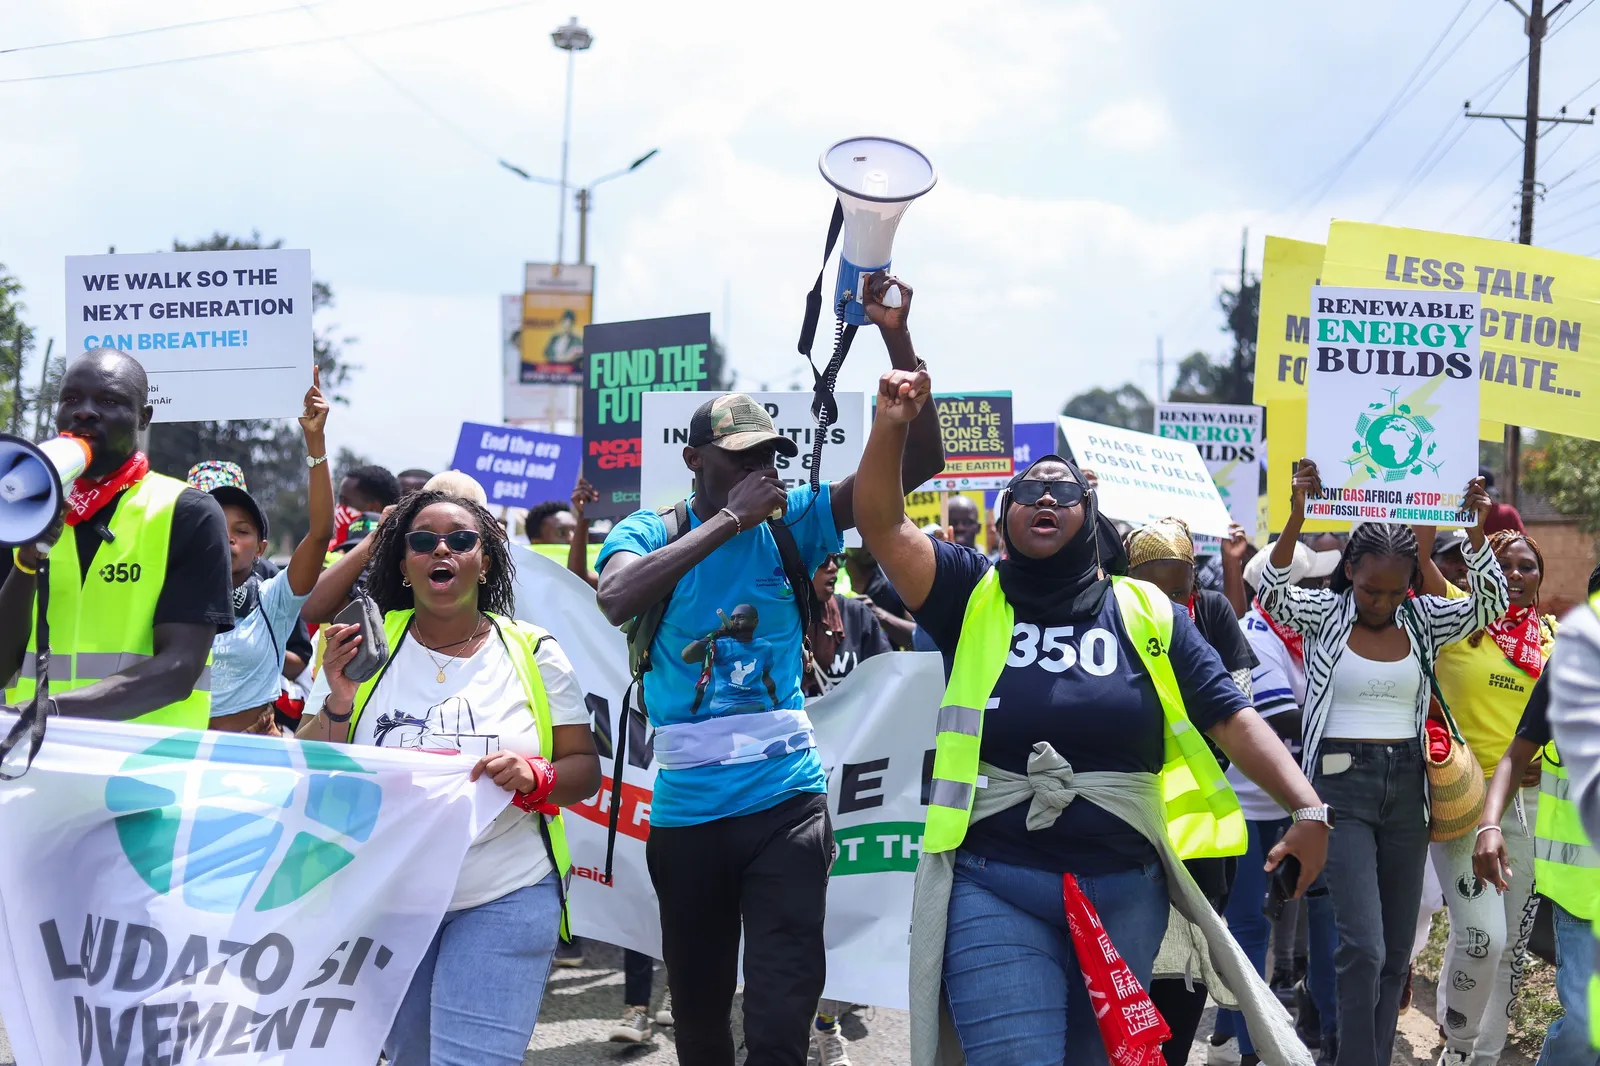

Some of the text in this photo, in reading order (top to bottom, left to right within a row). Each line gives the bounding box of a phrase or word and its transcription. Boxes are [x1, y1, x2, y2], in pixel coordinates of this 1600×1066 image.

[82, 268, 278, 292] WE WALK SO THE
[1385, 253, 1555, 304] LESS TALK
[83, 298, 293, 322] NEXT GENERATION
[1317, 297, 1474, 320] RENEWABLE
[83, 330, 249, 351] CAN BREATHE!
[1316, 318, 1474, 348] ENERGY
[1480, 308, 1581, 353] CTION
[590, 343, 708, 390] FUND THE
[1316, 347, 1473, 379] BUILDS
[1479, 350, 1581, 398] MATE...
[979, 400, 992, 413] &
[966, 413, 1001, 426] THE
[1159, 411, 1257, 425] RENEWABLE
[986, 426, 1000, 439] &
[1159, 424, 1256, 444] ENERGY
[480, 431, 561, 460] End the era
[589, 437, 642, 456] NOT
[1088, 435, 1184, 464] PHASE OUT
[475, 453, 556, 480] of coal and
[966, 460, 1006, 471] EARTH
[1083, 450, 1205, 483] FOSSIL FUELS
[492, 480, 528, 499] gas!
[1134, 479, 1215, 501] RENEWABLES
[1306, 503, 1476, 523] #ENDFOSSILFUELS #RENEWABLESNOW
[105, 563, 141, 583] 350
[1005, 622, 1118, 677] 350
[1488, 680, 1525, 693] STEALER
[1489, 673, 1516, 684] SCENE
[1121, 999, 1153, 1016] DRAW
[1124, 1006, 1156, 1024] THE
[1127, 1016, 1160, 1036] LINE
